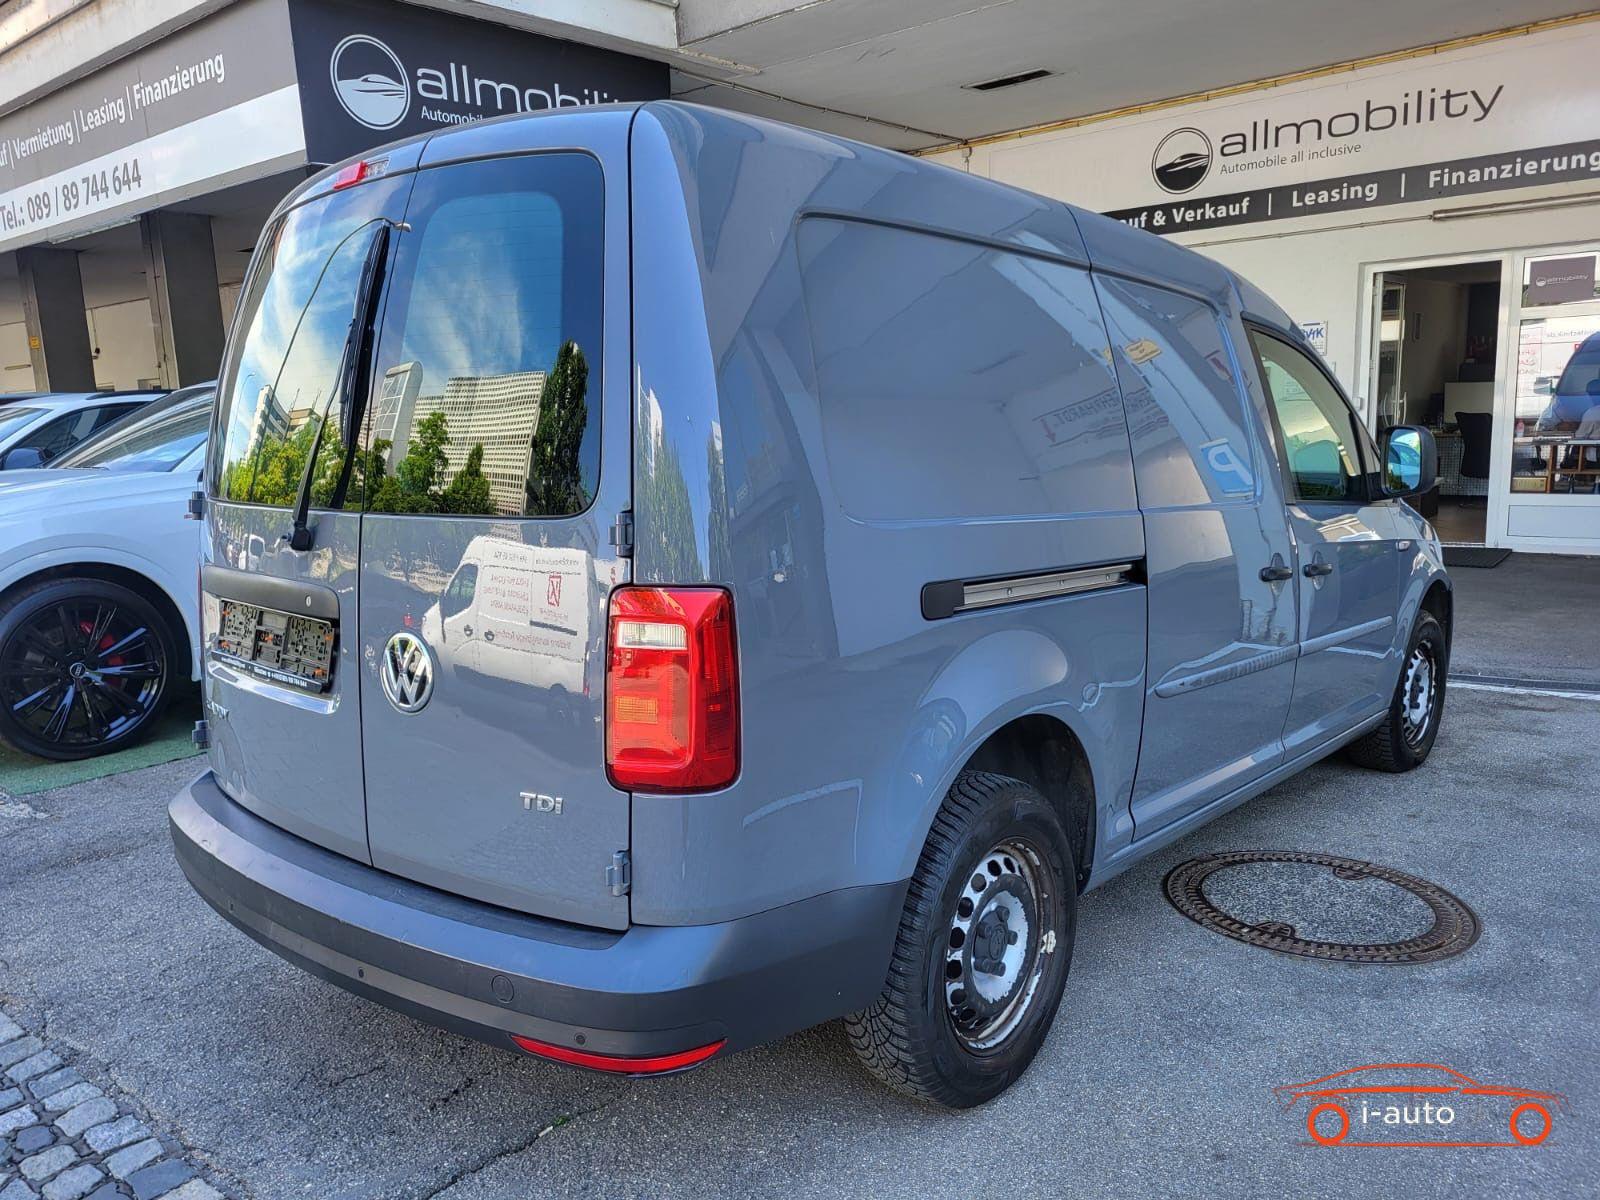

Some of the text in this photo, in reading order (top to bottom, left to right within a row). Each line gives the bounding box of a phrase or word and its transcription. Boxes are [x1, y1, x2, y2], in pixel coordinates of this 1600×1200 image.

[12, 119, 74, 160] Vermietung
[80, 98, 126, 132] Leasing
[133, 53, 225, 110] Finanzierung
[1220, 85, 1504, 157] allmobility
[0, 201, 25, 231] Tel.:
[27, 191, 51, 223] 089
[62, 181, 79, 211] 89
[82, 170, 109, 205] 744
[112, 158, 142, 195] 644
[1153, 210, 1166, 226] &
[1172, 197, 1250, 223] Verkauf
[1292, 182, 1378, 208] Leasing
[1429, 151, 1600, 189] Finanzierung
[1220, 142, 1361, 175] Automobile all inclusive
[519, 791, 564, 815] TDI
